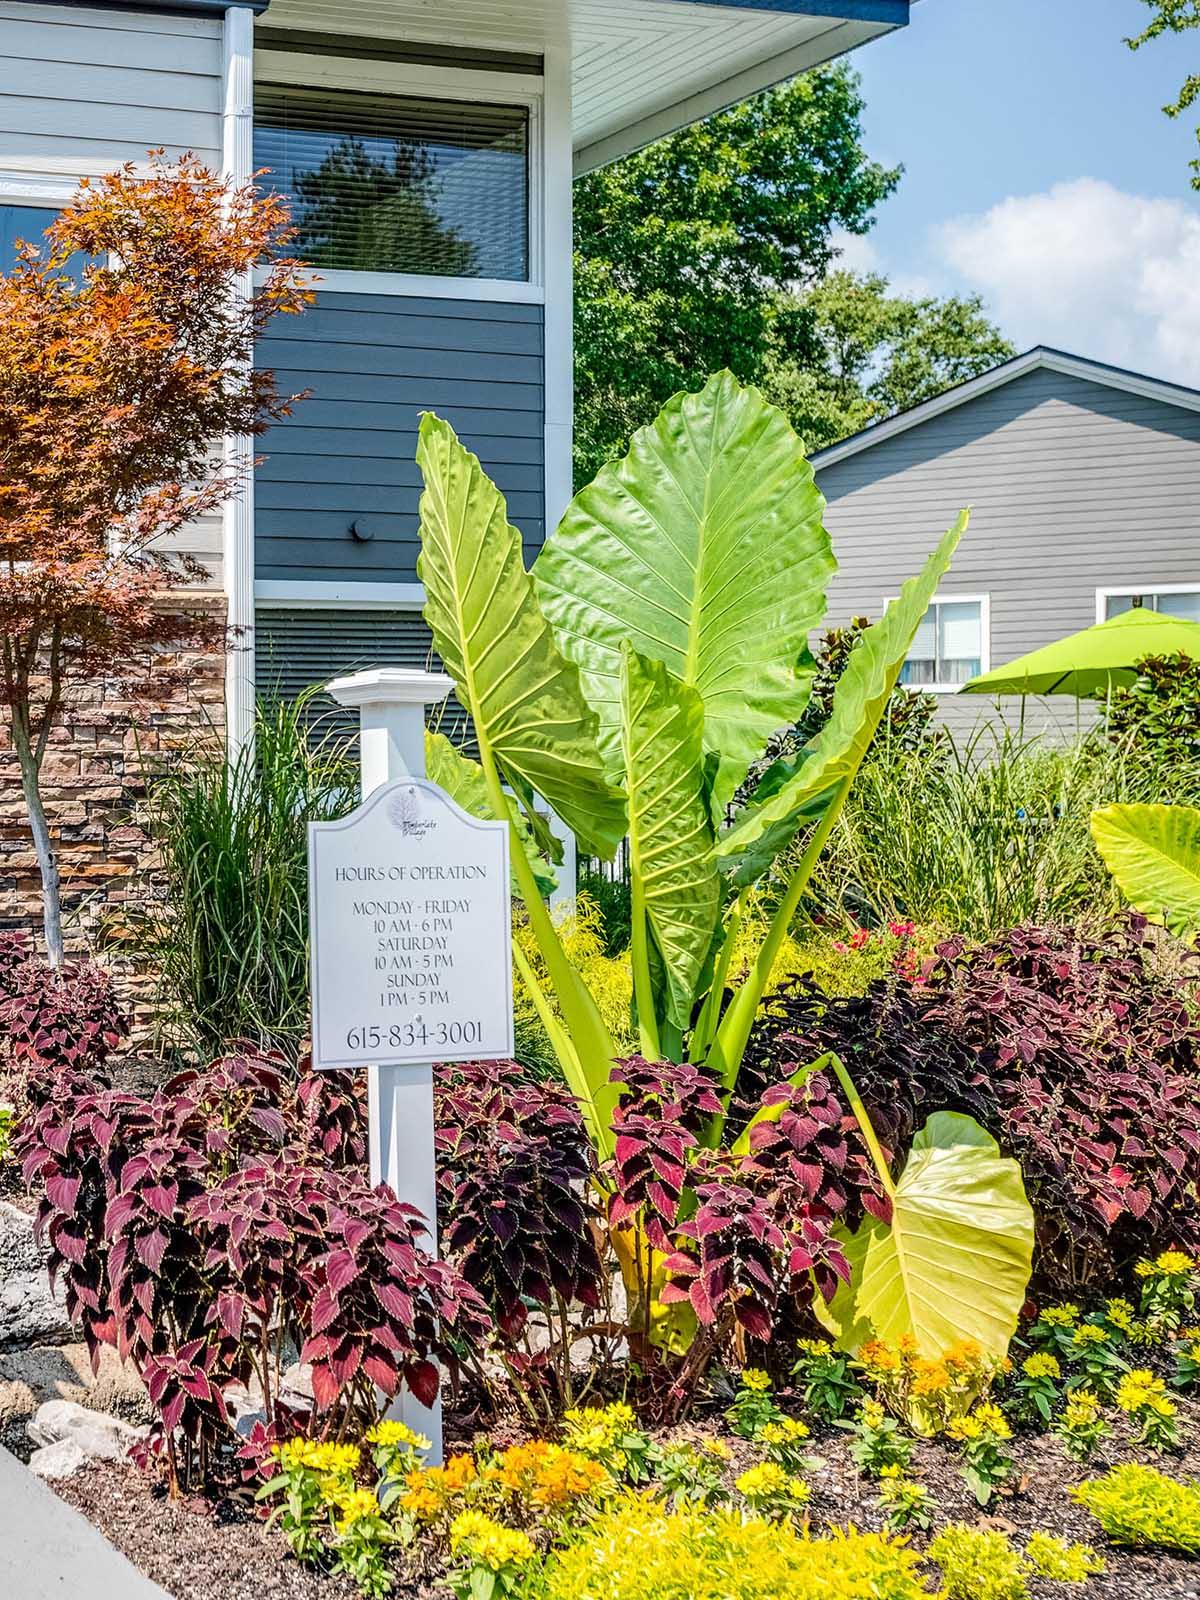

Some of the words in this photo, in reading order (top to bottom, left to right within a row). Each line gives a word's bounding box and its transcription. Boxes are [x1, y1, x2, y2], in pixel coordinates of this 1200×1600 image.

[335, 867, 385, 881] HOURS
[388, 866, 406, 880] OF
[410, 865, 487, 880] OPERATION
[352, 901, 413, 915] MONDAY
[425, 899, 471, 913] FRIDAY
[373, 919, 386, 933] 10
[389, 919, 411, 933] AM
[421, 919, 430, 932] 6
[433, 918, 453, 931] PM
[378, 936, 448, 951] SATURDAY
[375, 956, 387, 970] 10
[390, 956, 412, 969] AM
[423, 955, 431, 968] 5
[434, 954, 454, 968] PM
[387, 973, 440, 988] SUNDAY
[380, 993, 384, 1007] 1
[388, 992, 408, 1006] PM
[419, 991, 427, 1005] 5
[430, 991, 450, 1004] PM
[346, 1021, 483, 1050] 615-834-3001
